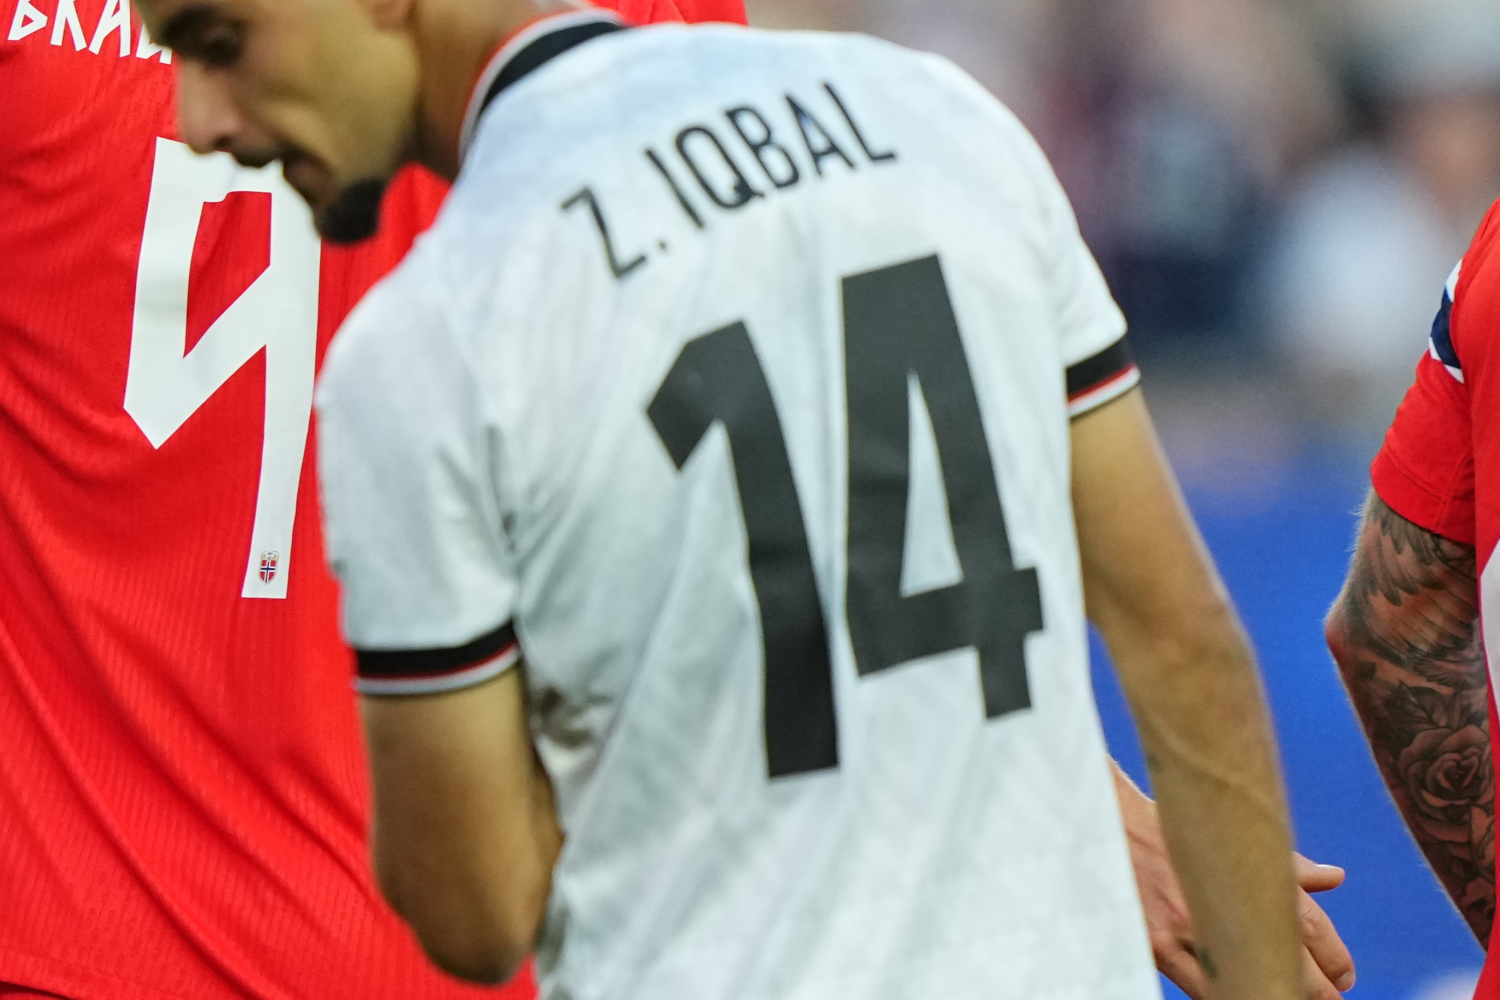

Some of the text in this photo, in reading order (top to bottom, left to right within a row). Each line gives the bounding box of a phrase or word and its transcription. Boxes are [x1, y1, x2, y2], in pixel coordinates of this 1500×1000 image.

[122, 136, 322, 600] 9
[560, 81, 896, 279] Z. IQBAL
[645, 253, 1045, 780] 14
